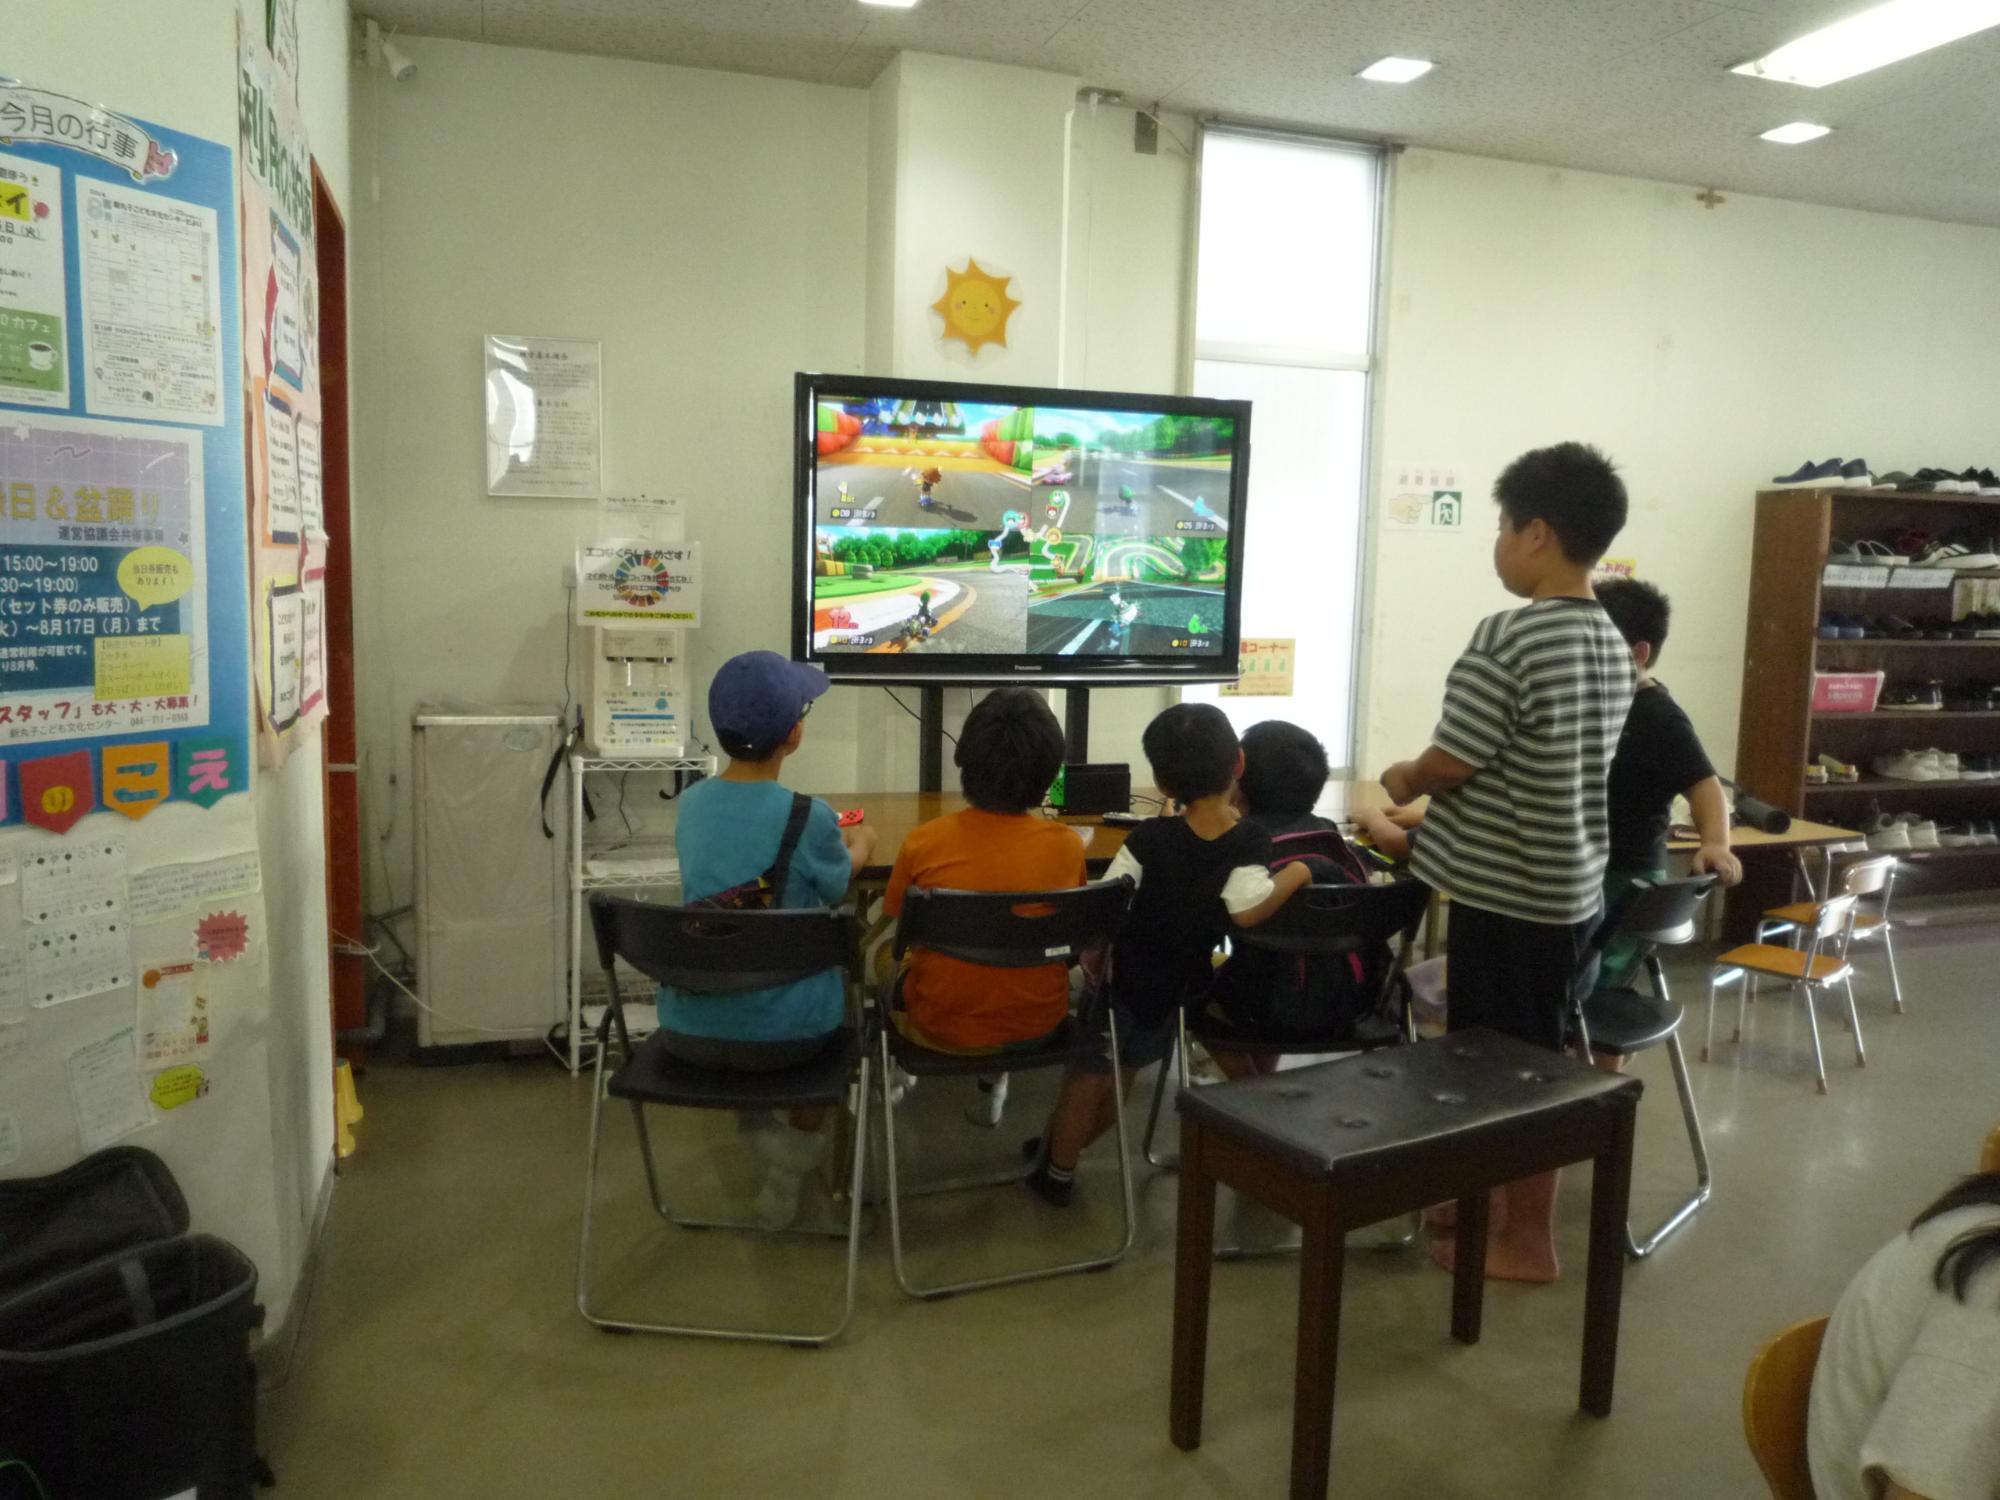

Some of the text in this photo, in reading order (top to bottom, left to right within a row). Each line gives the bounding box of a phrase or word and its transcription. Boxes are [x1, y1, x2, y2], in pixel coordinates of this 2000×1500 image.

[0, 101, 139, 159] 今月の行事
